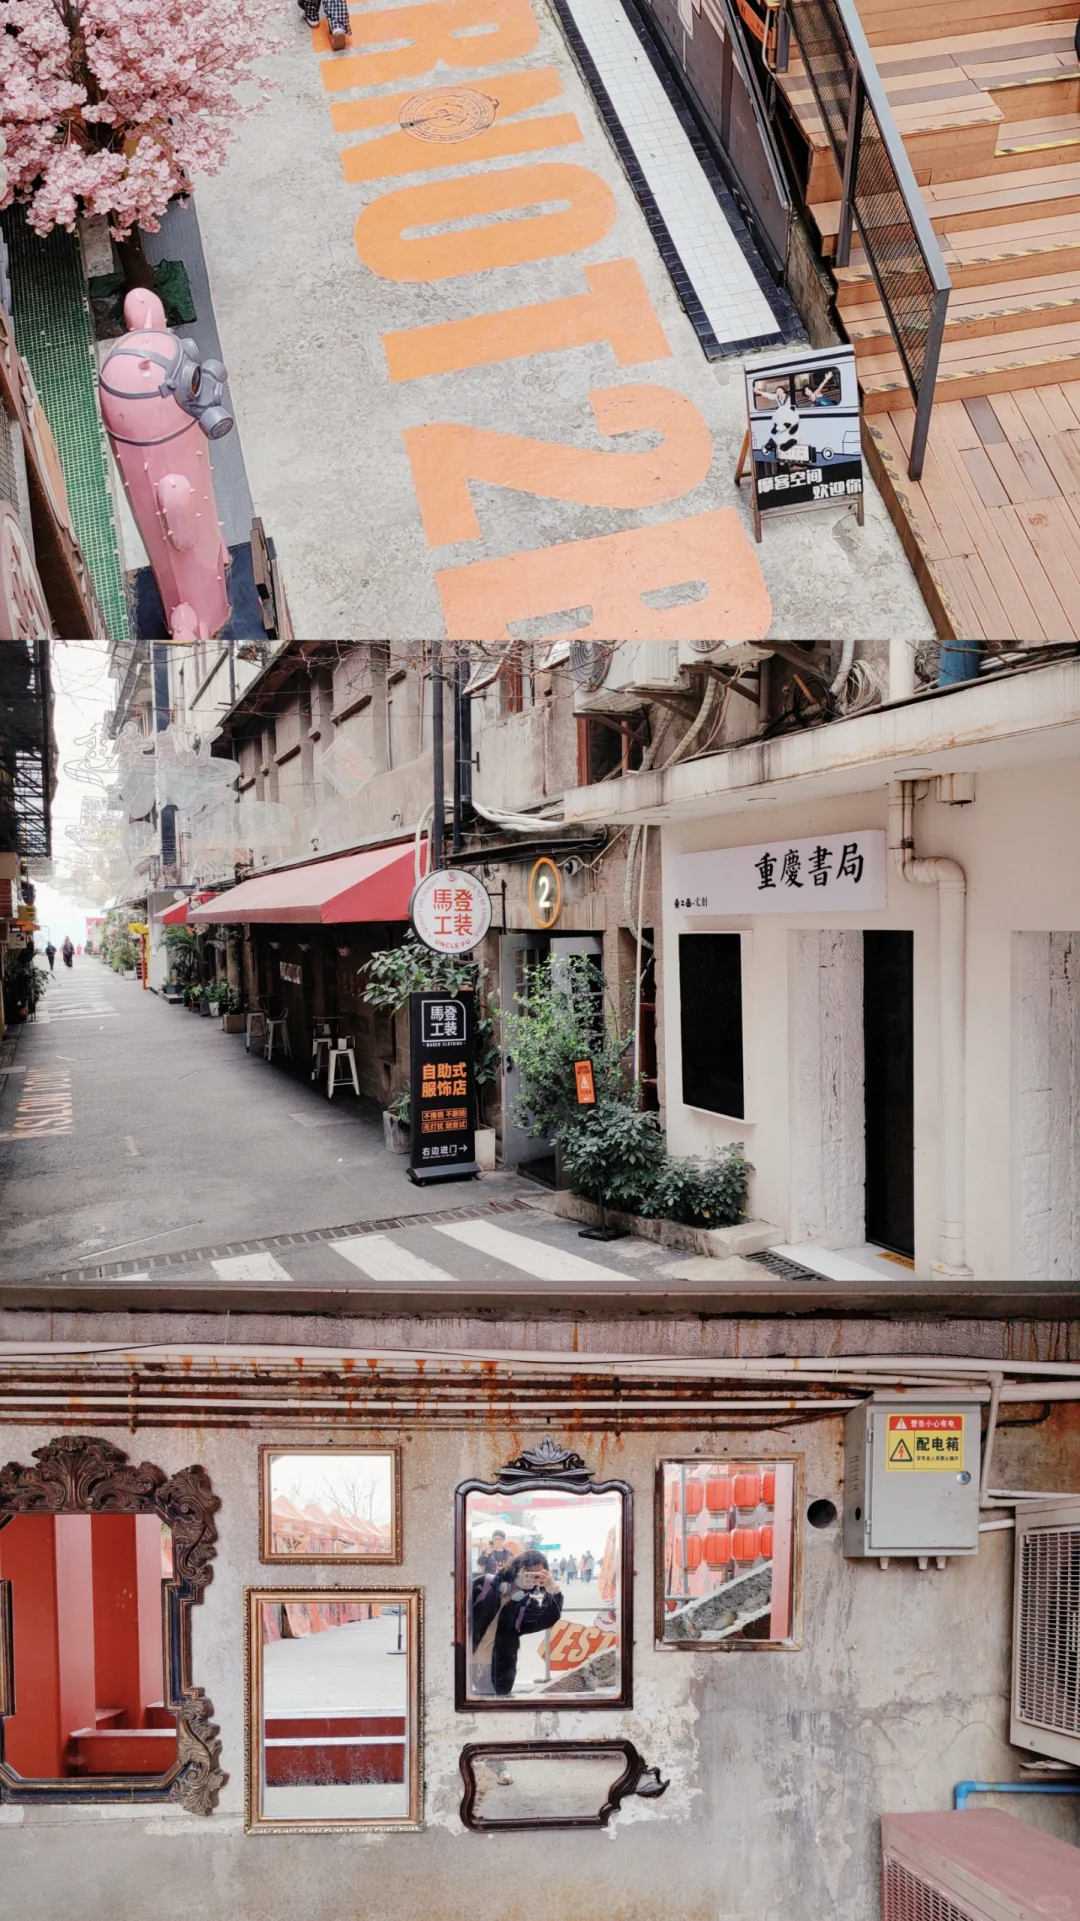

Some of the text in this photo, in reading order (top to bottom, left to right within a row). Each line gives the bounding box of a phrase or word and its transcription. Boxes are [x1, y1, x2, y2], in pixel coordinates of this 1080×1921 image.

[329, 65, 674, 383] NOT
[401, 383, 714, 549] 2
[758, 469, 823, 494] 摩客空间
[812, 478, 862, 500] 欢迎你
[754, 842, 865, 890] 重慶書局
[432, 888, 474, 912] 馬登
[476, 889, 483, 898] TO
[480, 899, 487, 907] BE
[538, 875, 551, 908] 2
[433, 913, 473, 936] 工装
[434, 938, 471, 949] UNCLE FU
[430, 1005, 458, 1021] 馬登
[430, 1021, 458, 1036] 工装
[422, 1061, 467, 1080] 自助式
[421, 1080, 467, 1098] 服饰店
[13, 1092, 73, 1129] SLOW
[422, 1144, 457, 1157] 右边进门
[916, 1436, 959, 1452] 配电箱
